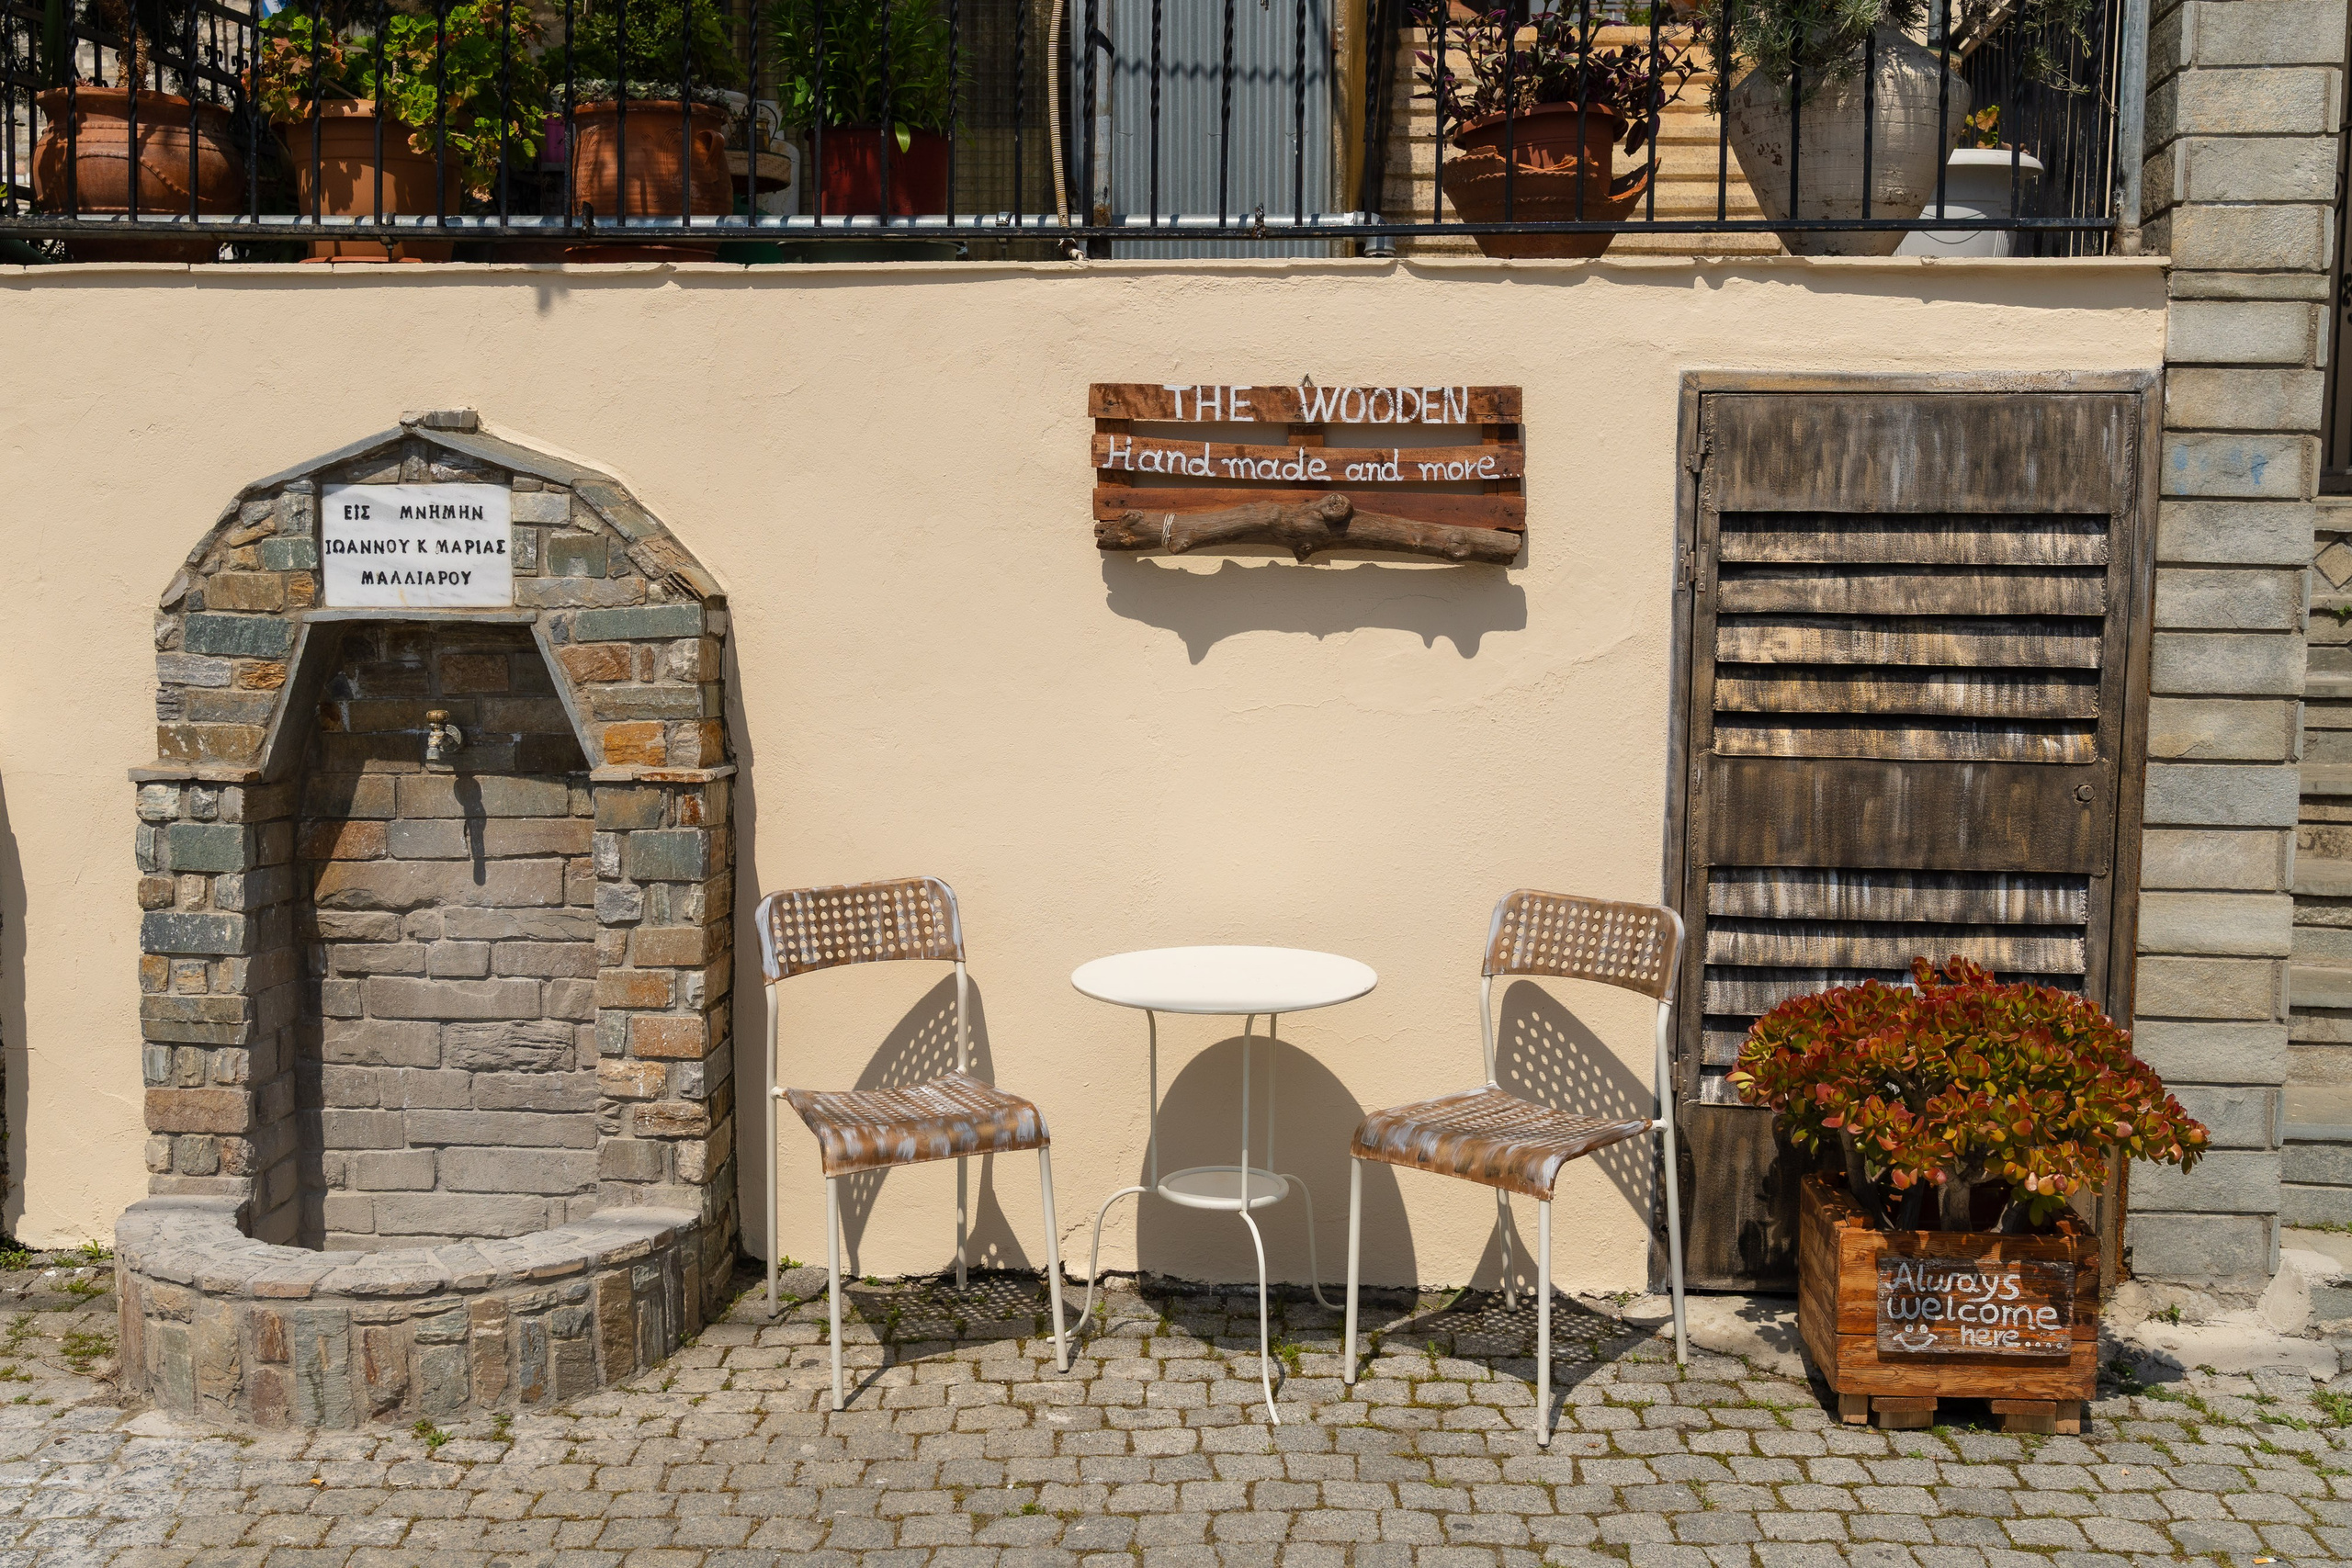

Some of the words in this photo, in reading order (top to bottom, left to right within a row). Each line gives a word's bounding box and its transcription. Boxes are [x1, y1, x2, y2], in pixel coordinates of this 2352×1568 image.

[1163, 385, 1254, 422] THE
[1297, 386, 1469, 423] WOODEN
[1221, 446, 1331, 481] made
[1346, 448, 1405, 481] and
[344, 504, 370, 520] ΕΙΣ
[400, 504, 483, 520] ΜΝΗΜΗΝ
[325, 539, 410, 555] ΙΩΑΝΝΟΥ
[435, 539, 506, 554] ΜΑΡΙΑΣ
[361, 570, 471, 585] ΜΑΛΛΙΑΡΟΥ
[1886, 1262, 2020, 1303] Always
